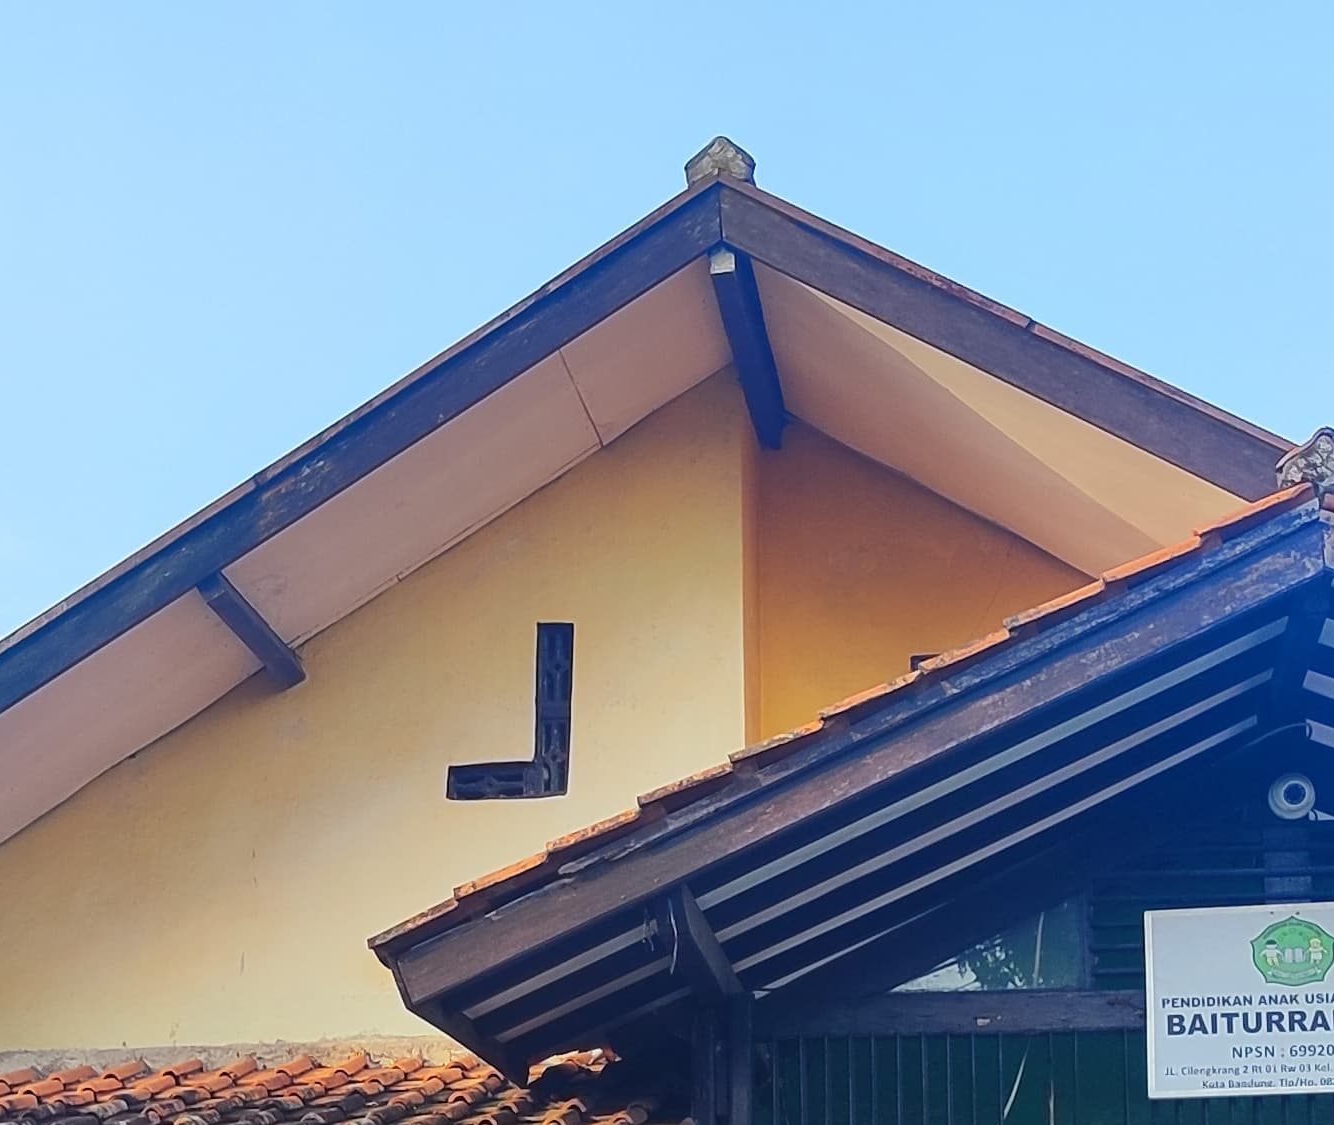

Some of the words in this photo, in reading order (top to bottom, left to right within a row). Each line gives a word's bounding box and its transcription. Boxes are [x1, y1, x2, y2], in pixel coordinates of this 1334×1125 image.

[1162, 995, 1253, 1009] PENDIDIKAN
[1258, 994, 1300, 1006] ANAK
[1232, 1046, 1275, 1058] NPSN
[1181, 1065, 1240, 1076] Cilengkrang
[1242, 1065, 1248, 1074] 2
[1251, 1065, 1262, 1074] Rt
[1265, 1064, 1277, 1073] 01
[1280, 1064, 1296, 1073] Rw
[1299, 1063, 1311, 1073] 03
[1314, 1063, 1333, 1072] Kel.
[1202, 1080, 1225, 1089] Kota
